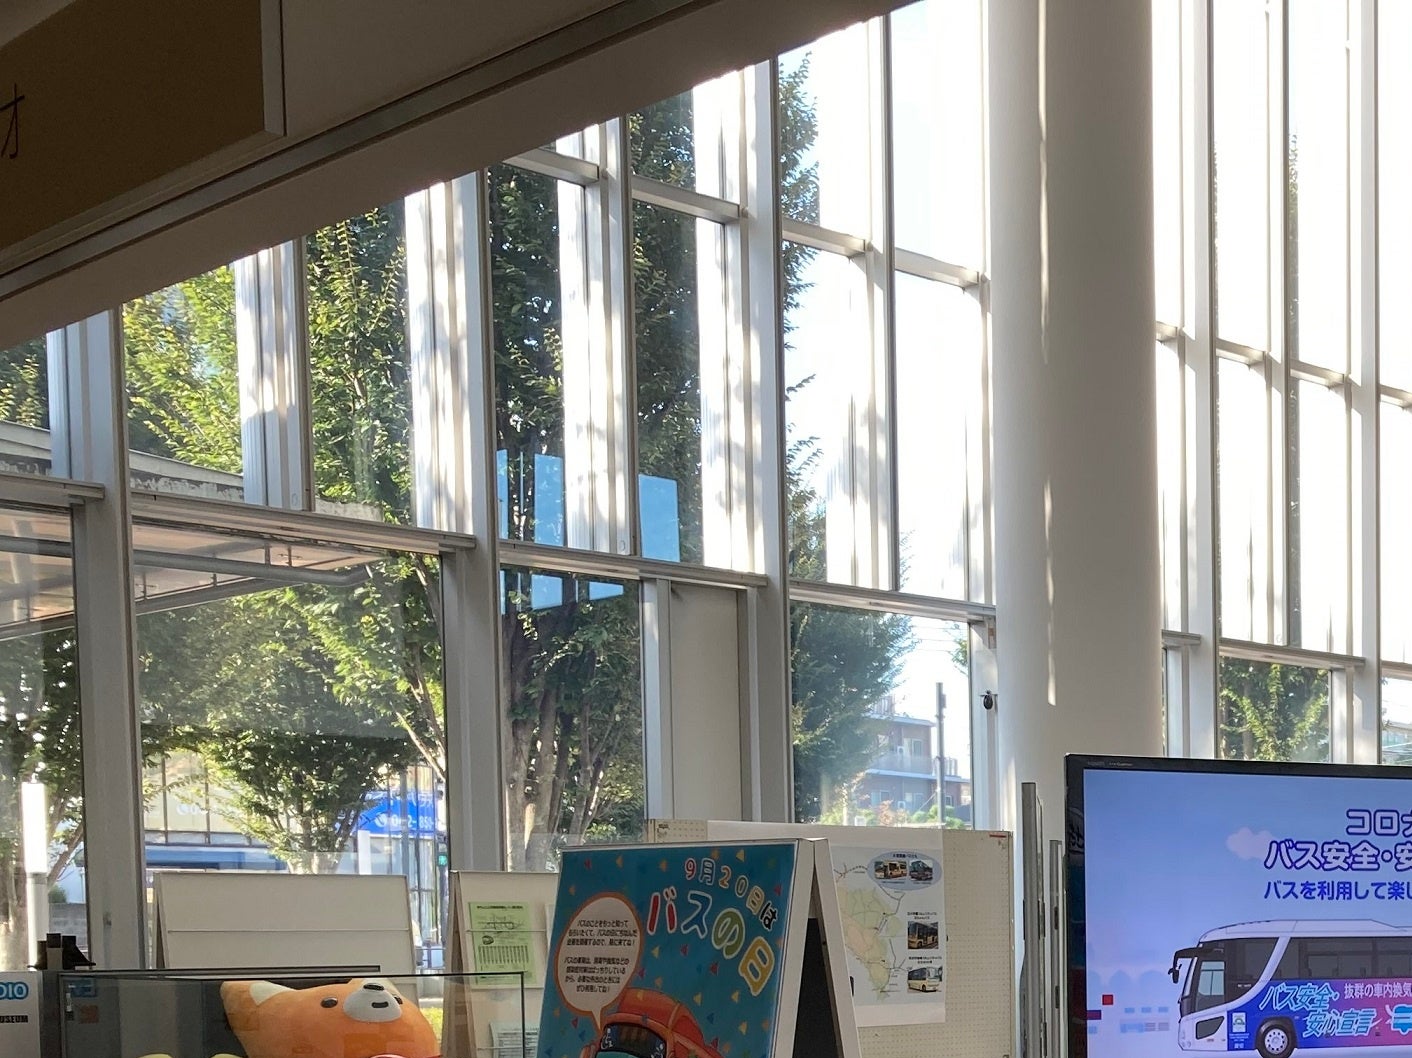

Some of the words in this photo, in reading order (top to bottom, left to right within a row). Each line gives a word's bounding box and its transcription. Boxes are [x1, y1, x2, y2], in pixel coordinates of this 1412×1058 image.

[684, 857, 778, 932] 9月20日は
[646, 885, 776, 997] バスの日
[1302, 1008, 1377, 1038] 安心宣言
